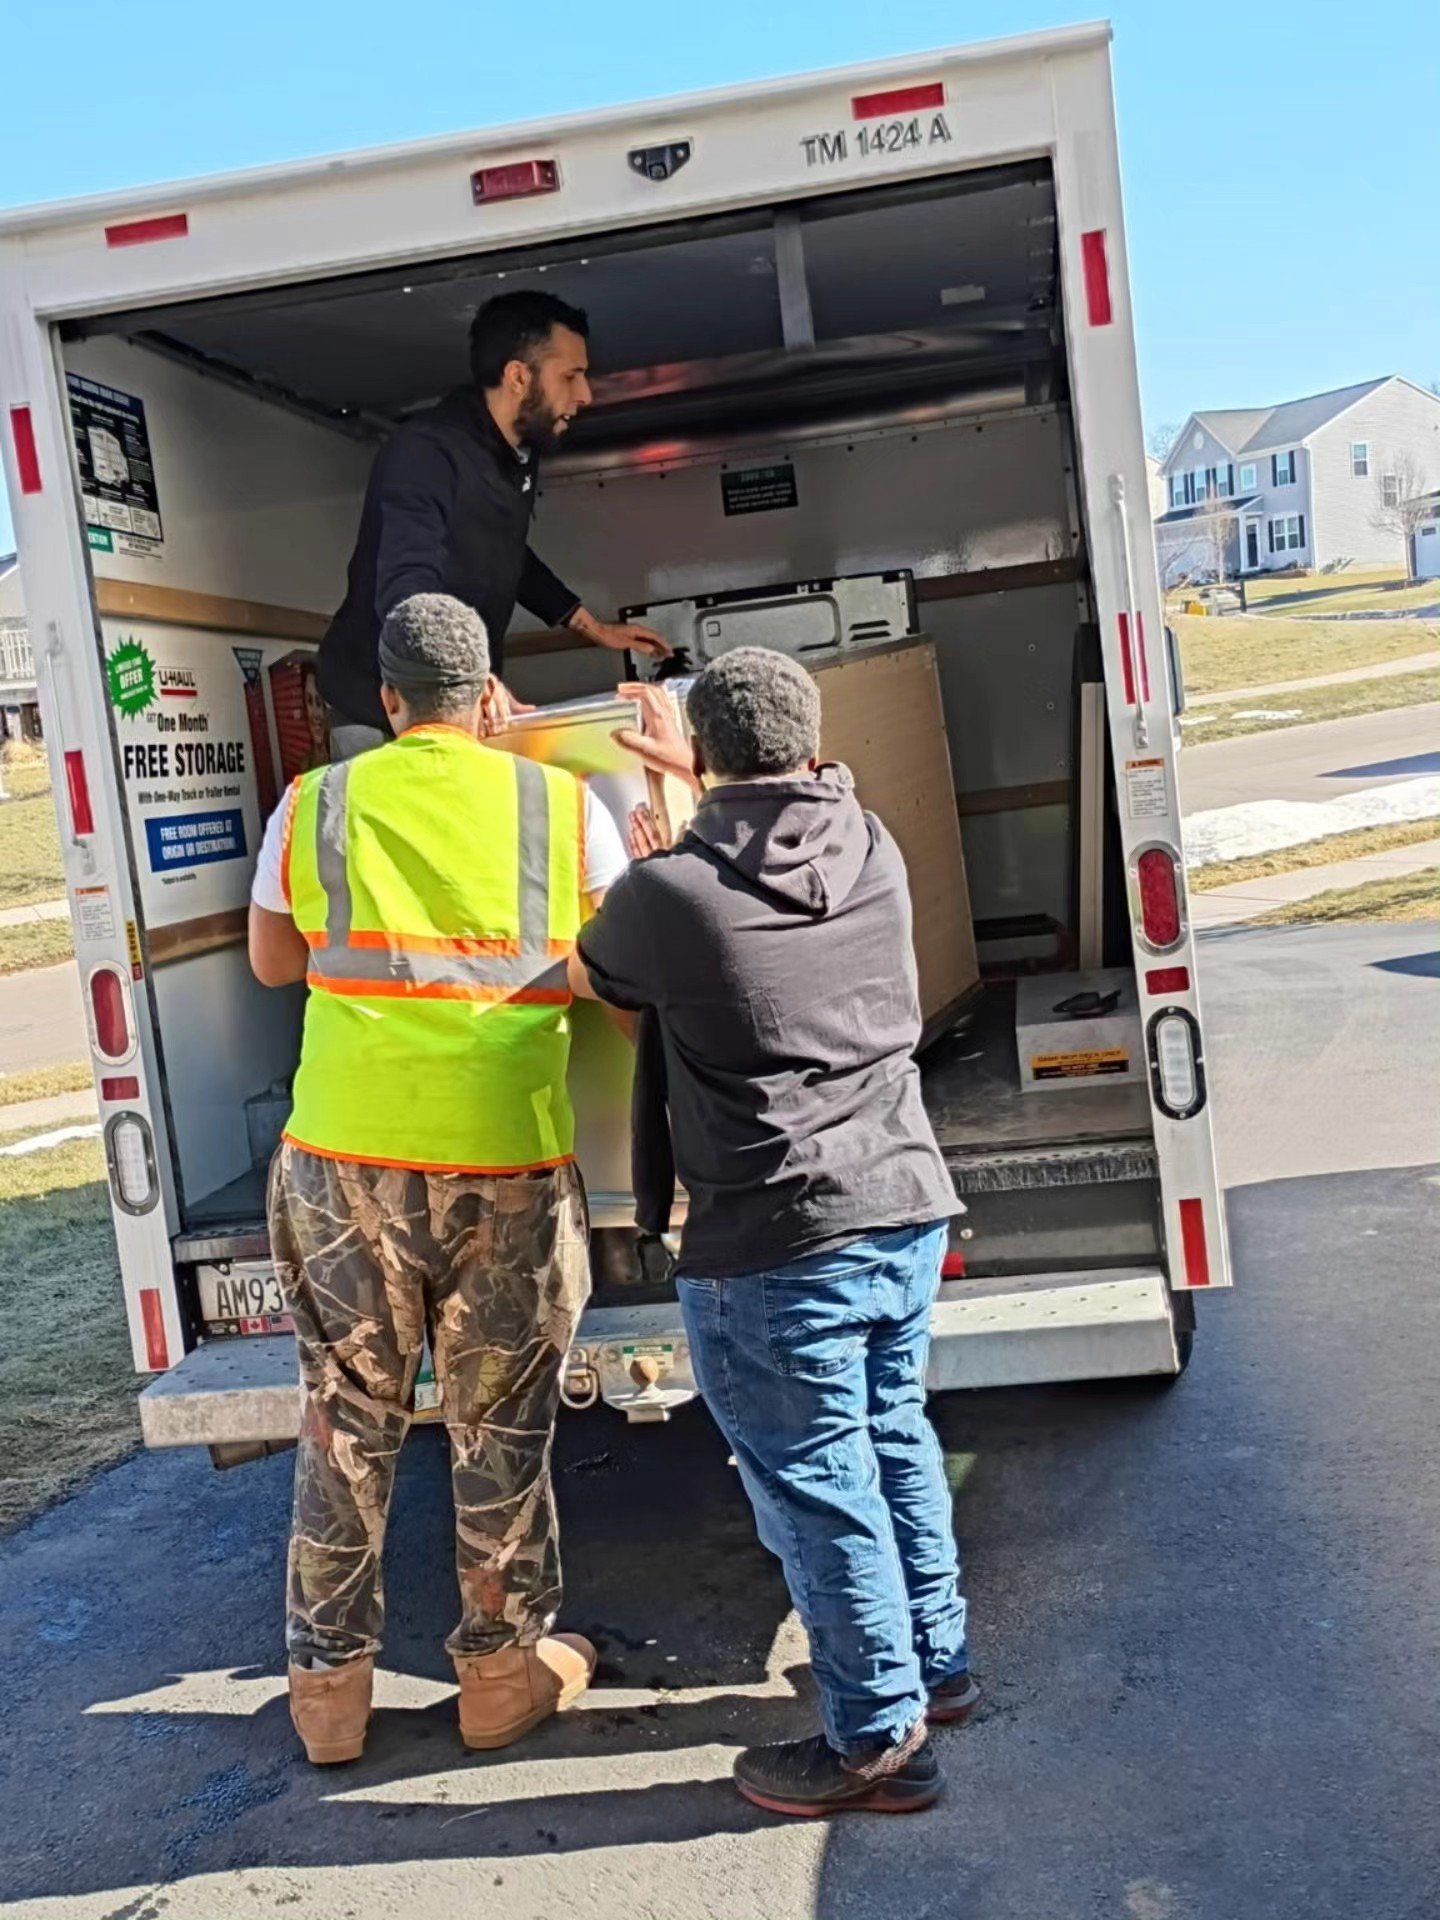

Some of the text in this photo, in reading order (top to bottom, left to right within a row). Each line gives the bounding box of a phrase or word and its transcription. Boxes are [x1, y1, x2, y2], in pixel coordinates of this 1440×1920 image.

[800, 113, 952, 166] TM 1424 A
[120, 668, 144, 690] OFFER
[159, 670, 196, 688] U-HAUL
[157, 712, 176, 732] One
[124, 742, 245, 779] FREE STORAGE
[138, 791, 152, 804] With
[160, 826, 178, 841] FREE
[216, 1276, 283, 1317] AM93
